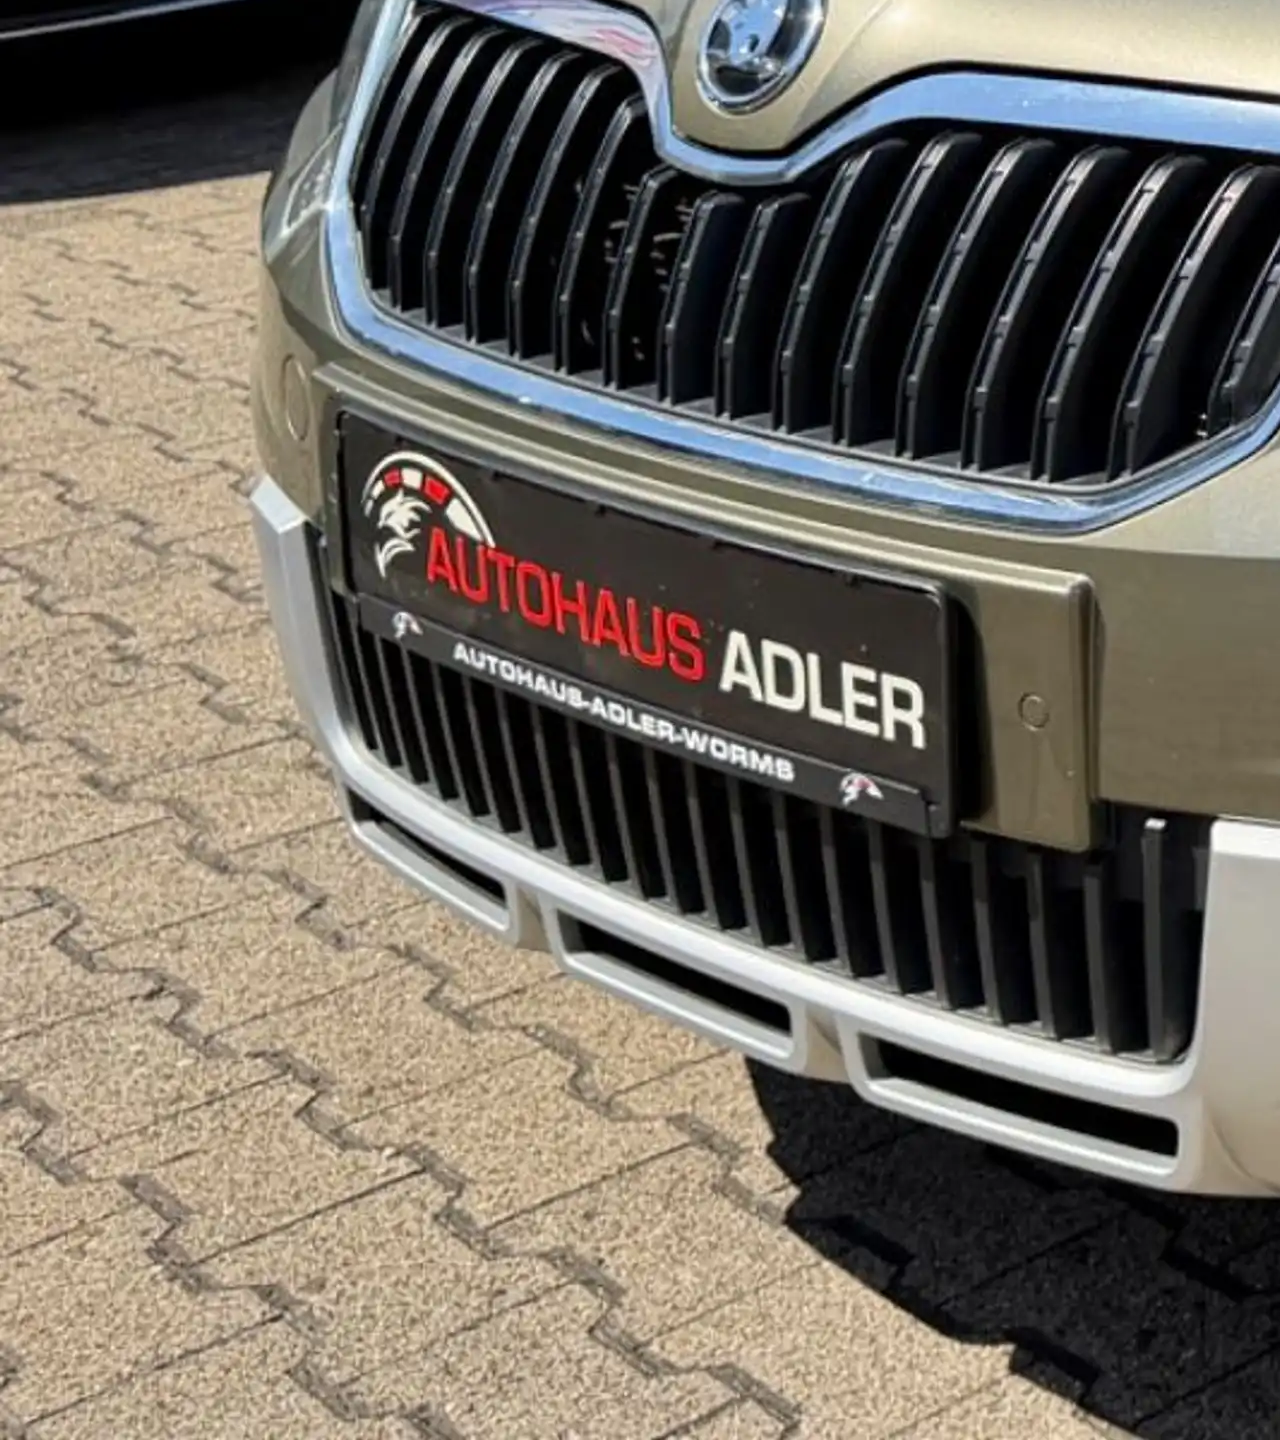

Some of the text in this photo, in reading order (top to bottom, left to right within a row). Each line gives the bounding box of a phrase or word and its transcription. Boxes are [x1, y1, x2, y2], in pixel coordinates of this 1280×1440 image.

[426, 526, 926, 750] AUTOHAUS ADLER
[453, 642, 796, 783] AUTOHAUS-ADLER-WORMS
